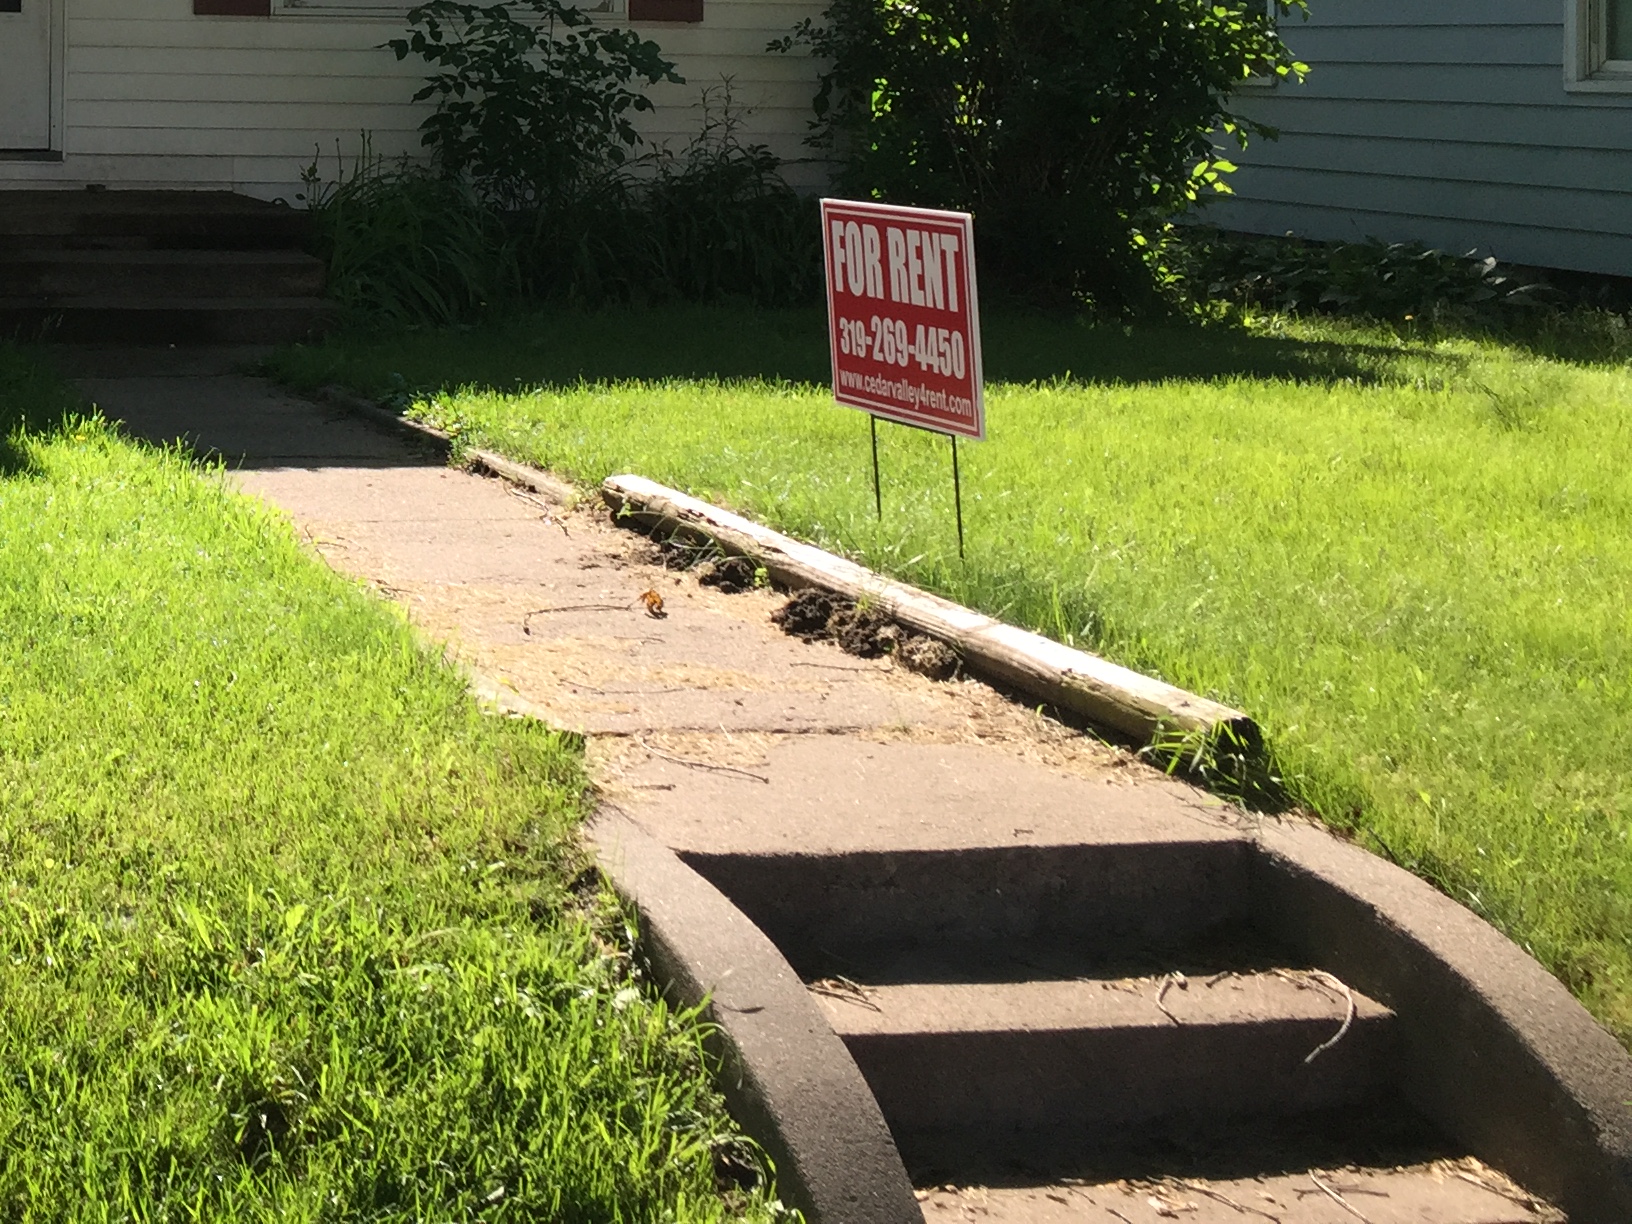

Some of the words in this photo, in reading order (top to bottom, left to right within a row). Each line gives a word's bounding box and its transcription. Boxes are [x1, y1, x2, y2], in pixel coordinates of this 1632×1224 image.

[831, 219, 884, 299] FOR
[886, 226, 959, 312] RENT
[839, 316, 966, 380] 319-269-4450
[839, 369, 972, 417] www.cedarvalley4rent.com
